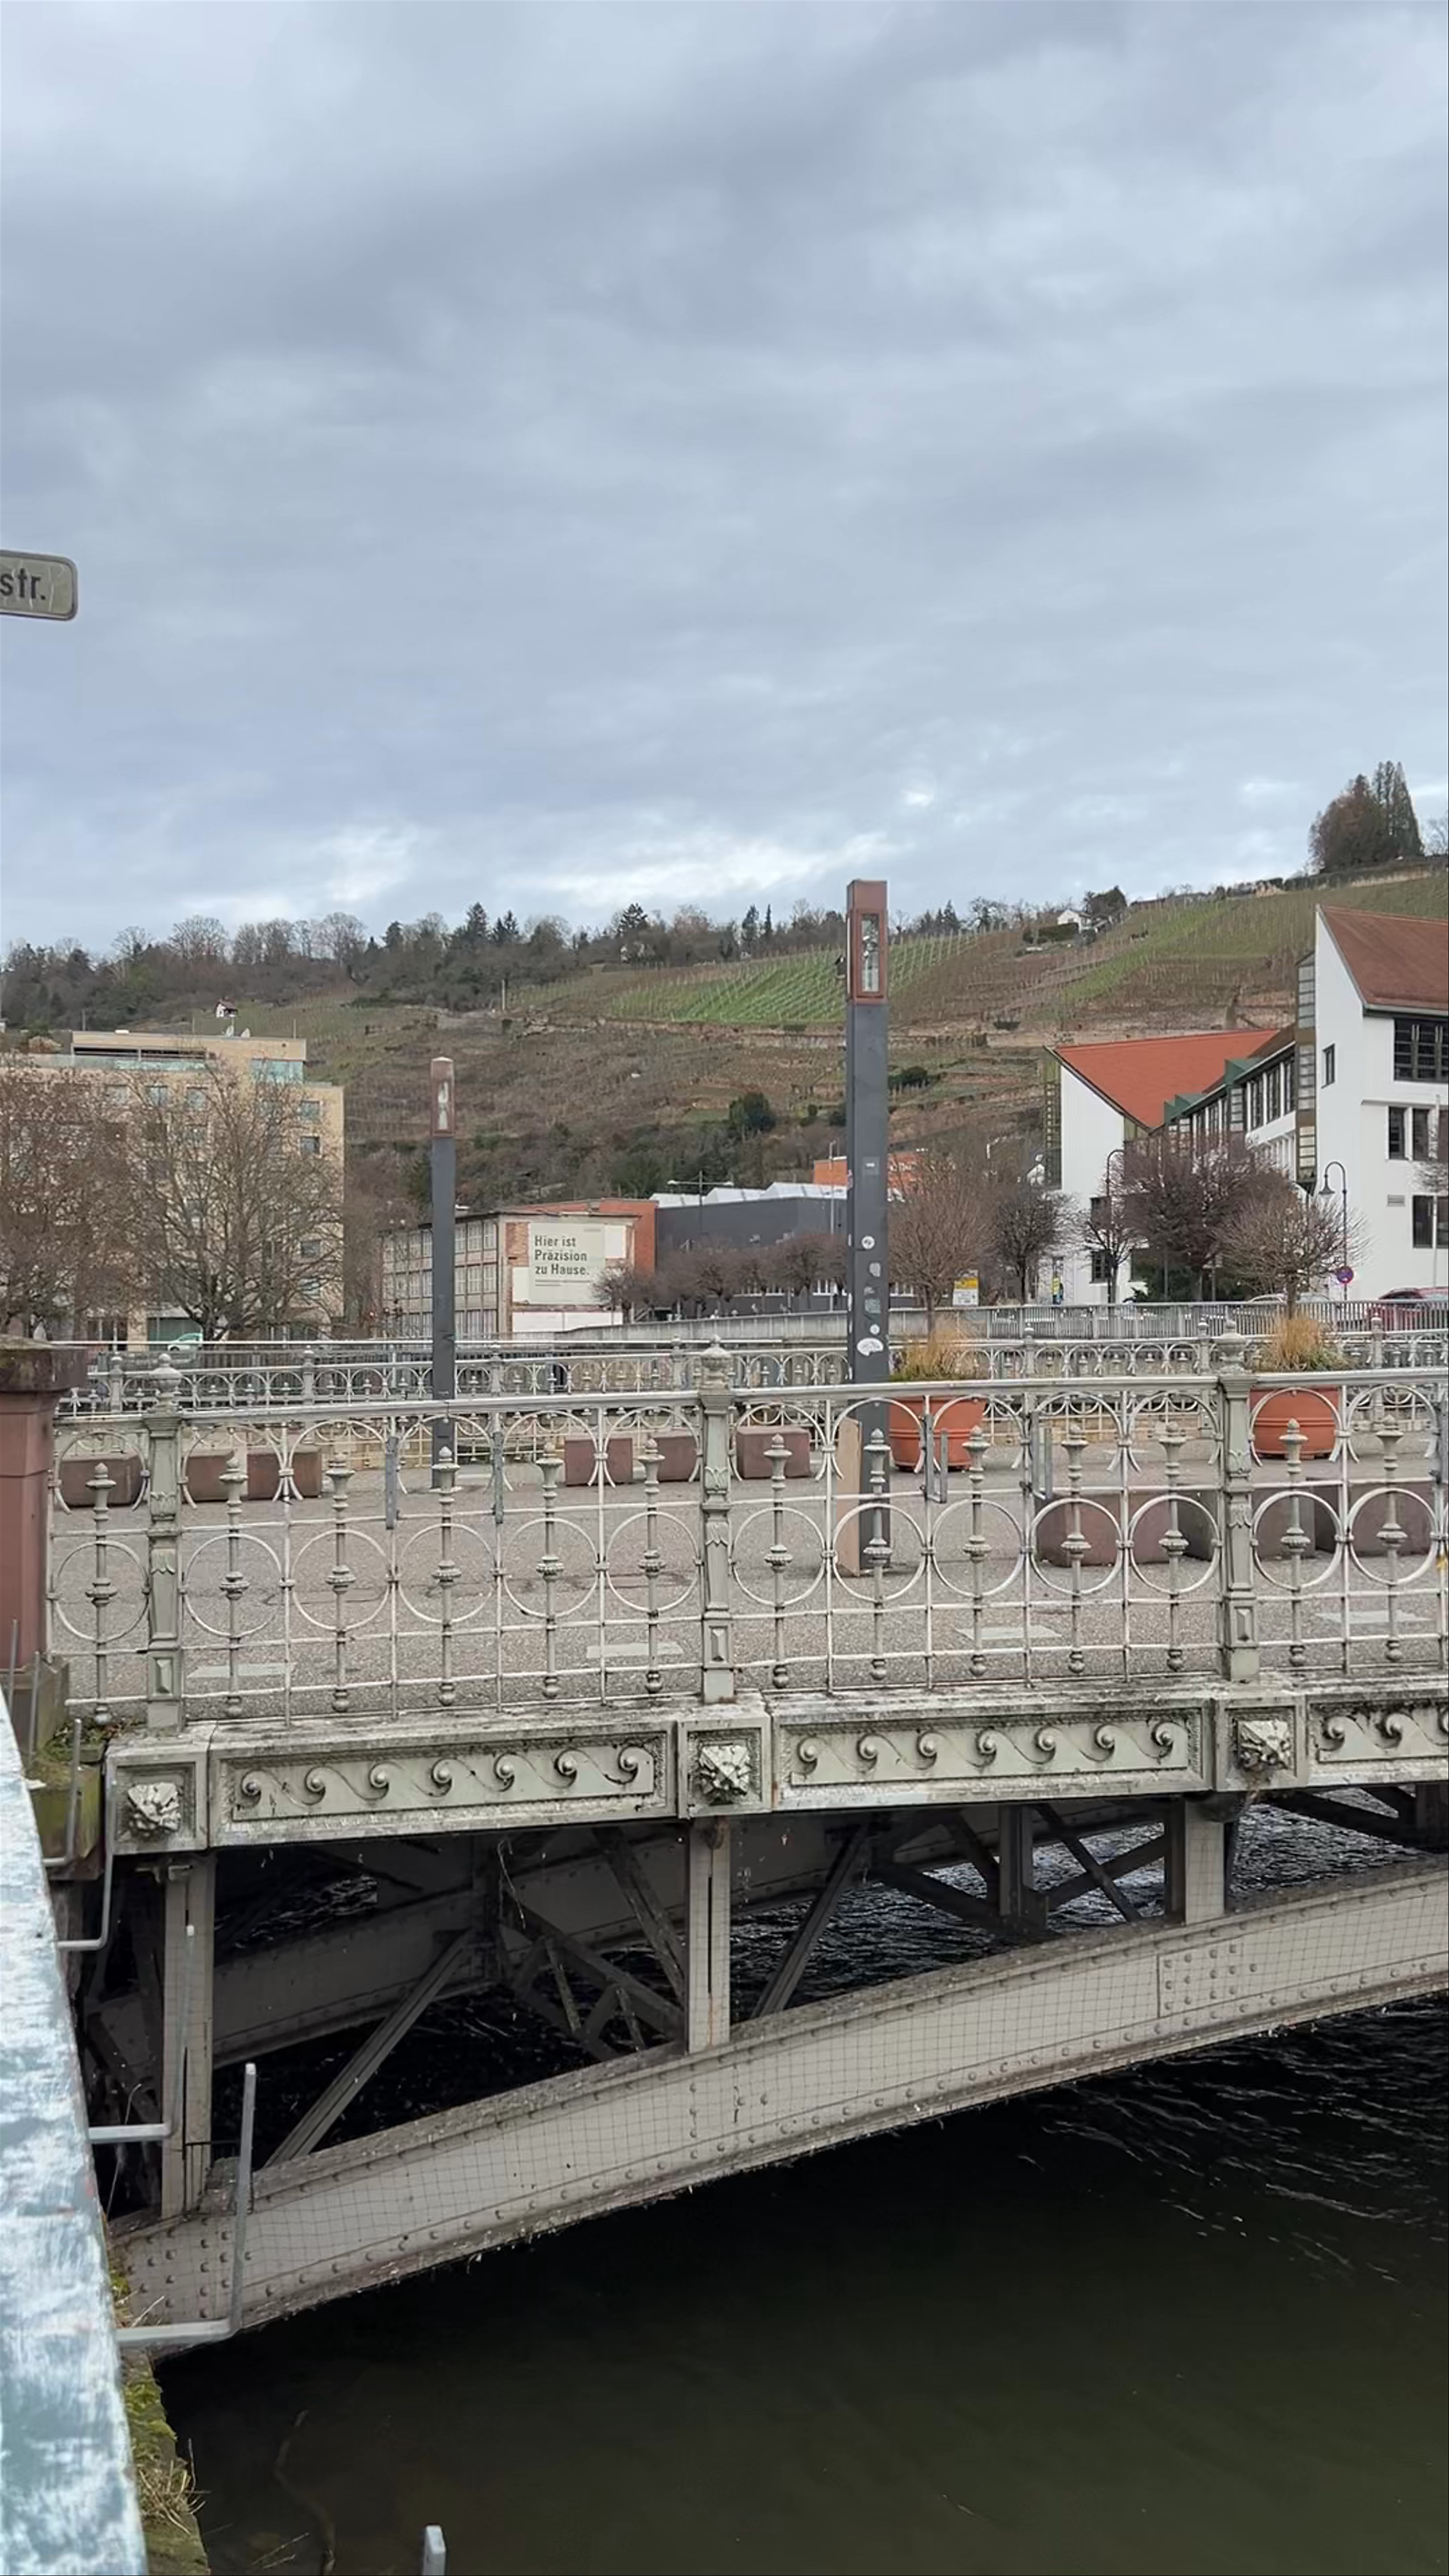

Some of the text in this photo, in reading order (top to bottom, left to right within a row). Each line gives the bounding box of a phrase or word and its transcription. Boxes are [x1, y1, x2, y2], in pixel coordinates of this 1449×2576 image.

[534, 1235, 576, 1247] Hier ist
[534, 1249, 587, 1261] Präzision
[535, 1264, 590, 1275] zu Hause.
